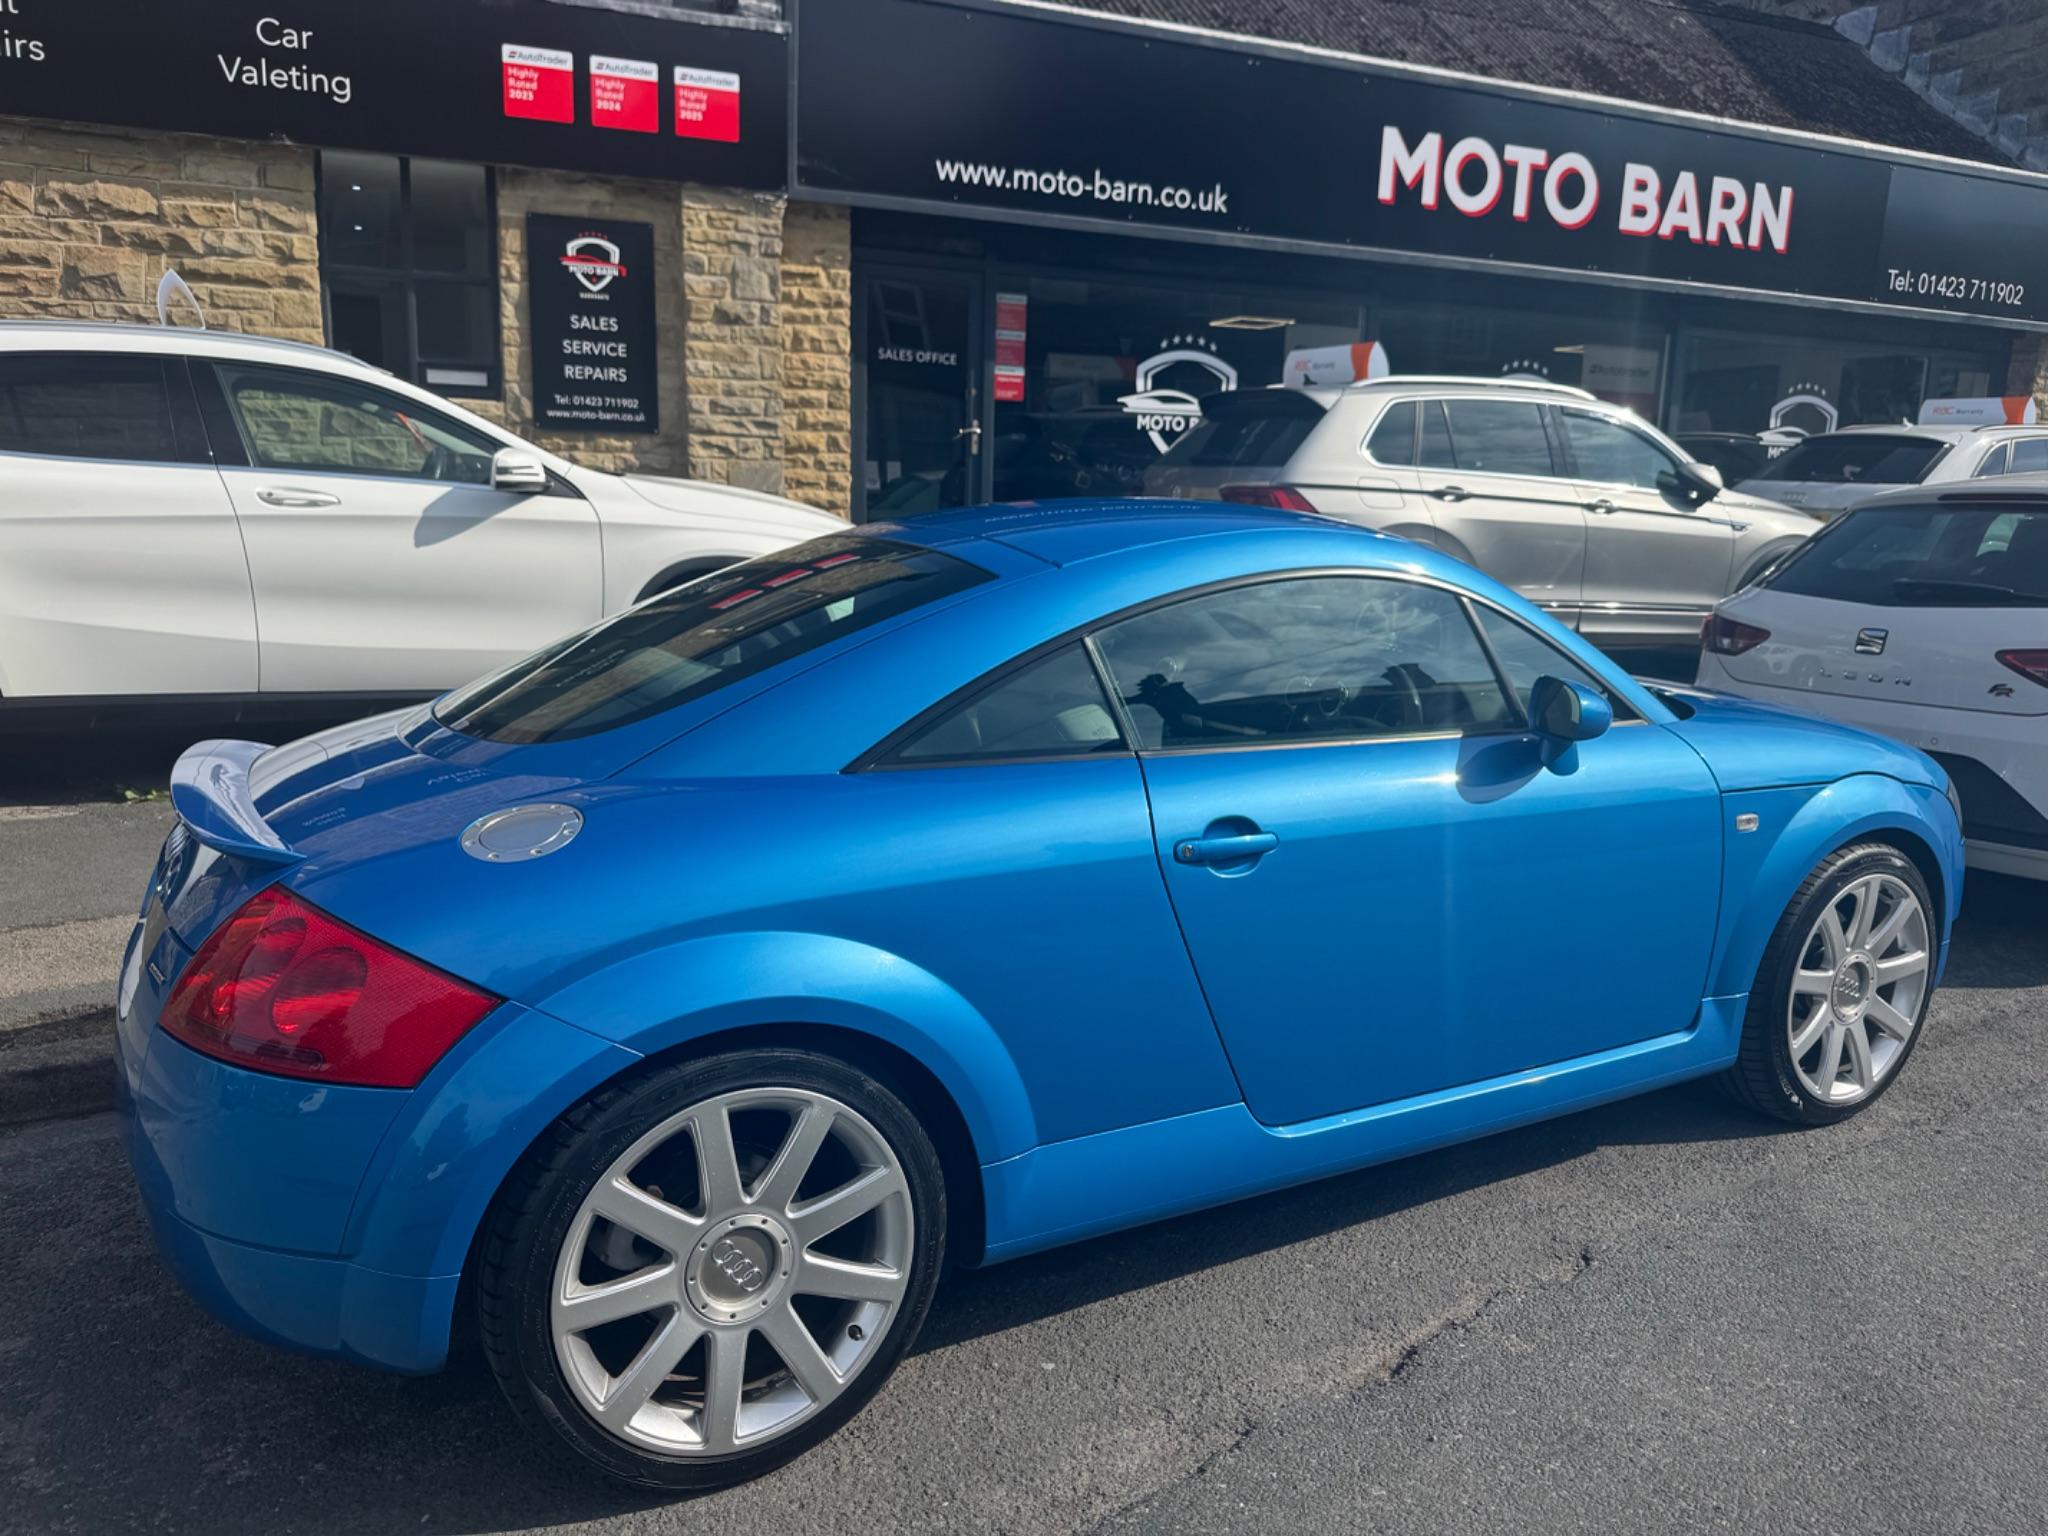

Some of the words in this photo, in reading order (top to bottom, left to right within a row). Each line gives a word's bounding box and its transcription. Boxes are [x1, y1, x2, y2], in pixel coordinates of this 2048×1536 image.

[256, 17, 313, 49] Car
[217, 54, 351, 103] Valeting
[507, 66, 539, 80] Highly
[507, 77, 538, 91] Rated
[595, 78, 625, 91] Highly
[508, 88, 534, 101] 2023
[596, 99, 622, 112] 2024
[935, 158, 1229, 214] www.moto-barn.co.uk
[1377, 125, 1599, 230] MOTO
[1618, 162, 1794, 255] BARN
[1888, 269, 1914, 292] Tel:
[1918, 272, 1967, 299] 01423
[1970, 279, 2025, 305] 711902
[569, 314, 619, 332] SALES
[562, 339, 628, 358] SERVICE
[878, 347, 913, 362] SALES
[915, 350, 957, 366] OFFICE
[564, 364, 628, 383] REPAIRS
[554, 394, 571, 406] Tel:
[573, 395, 603, 408] 01423
[604, 397, 639, 408] 711902
[546, 408, 645, 423] www.moto-barn.co.uk
[1136, 414, 1185, 432] MOTO
